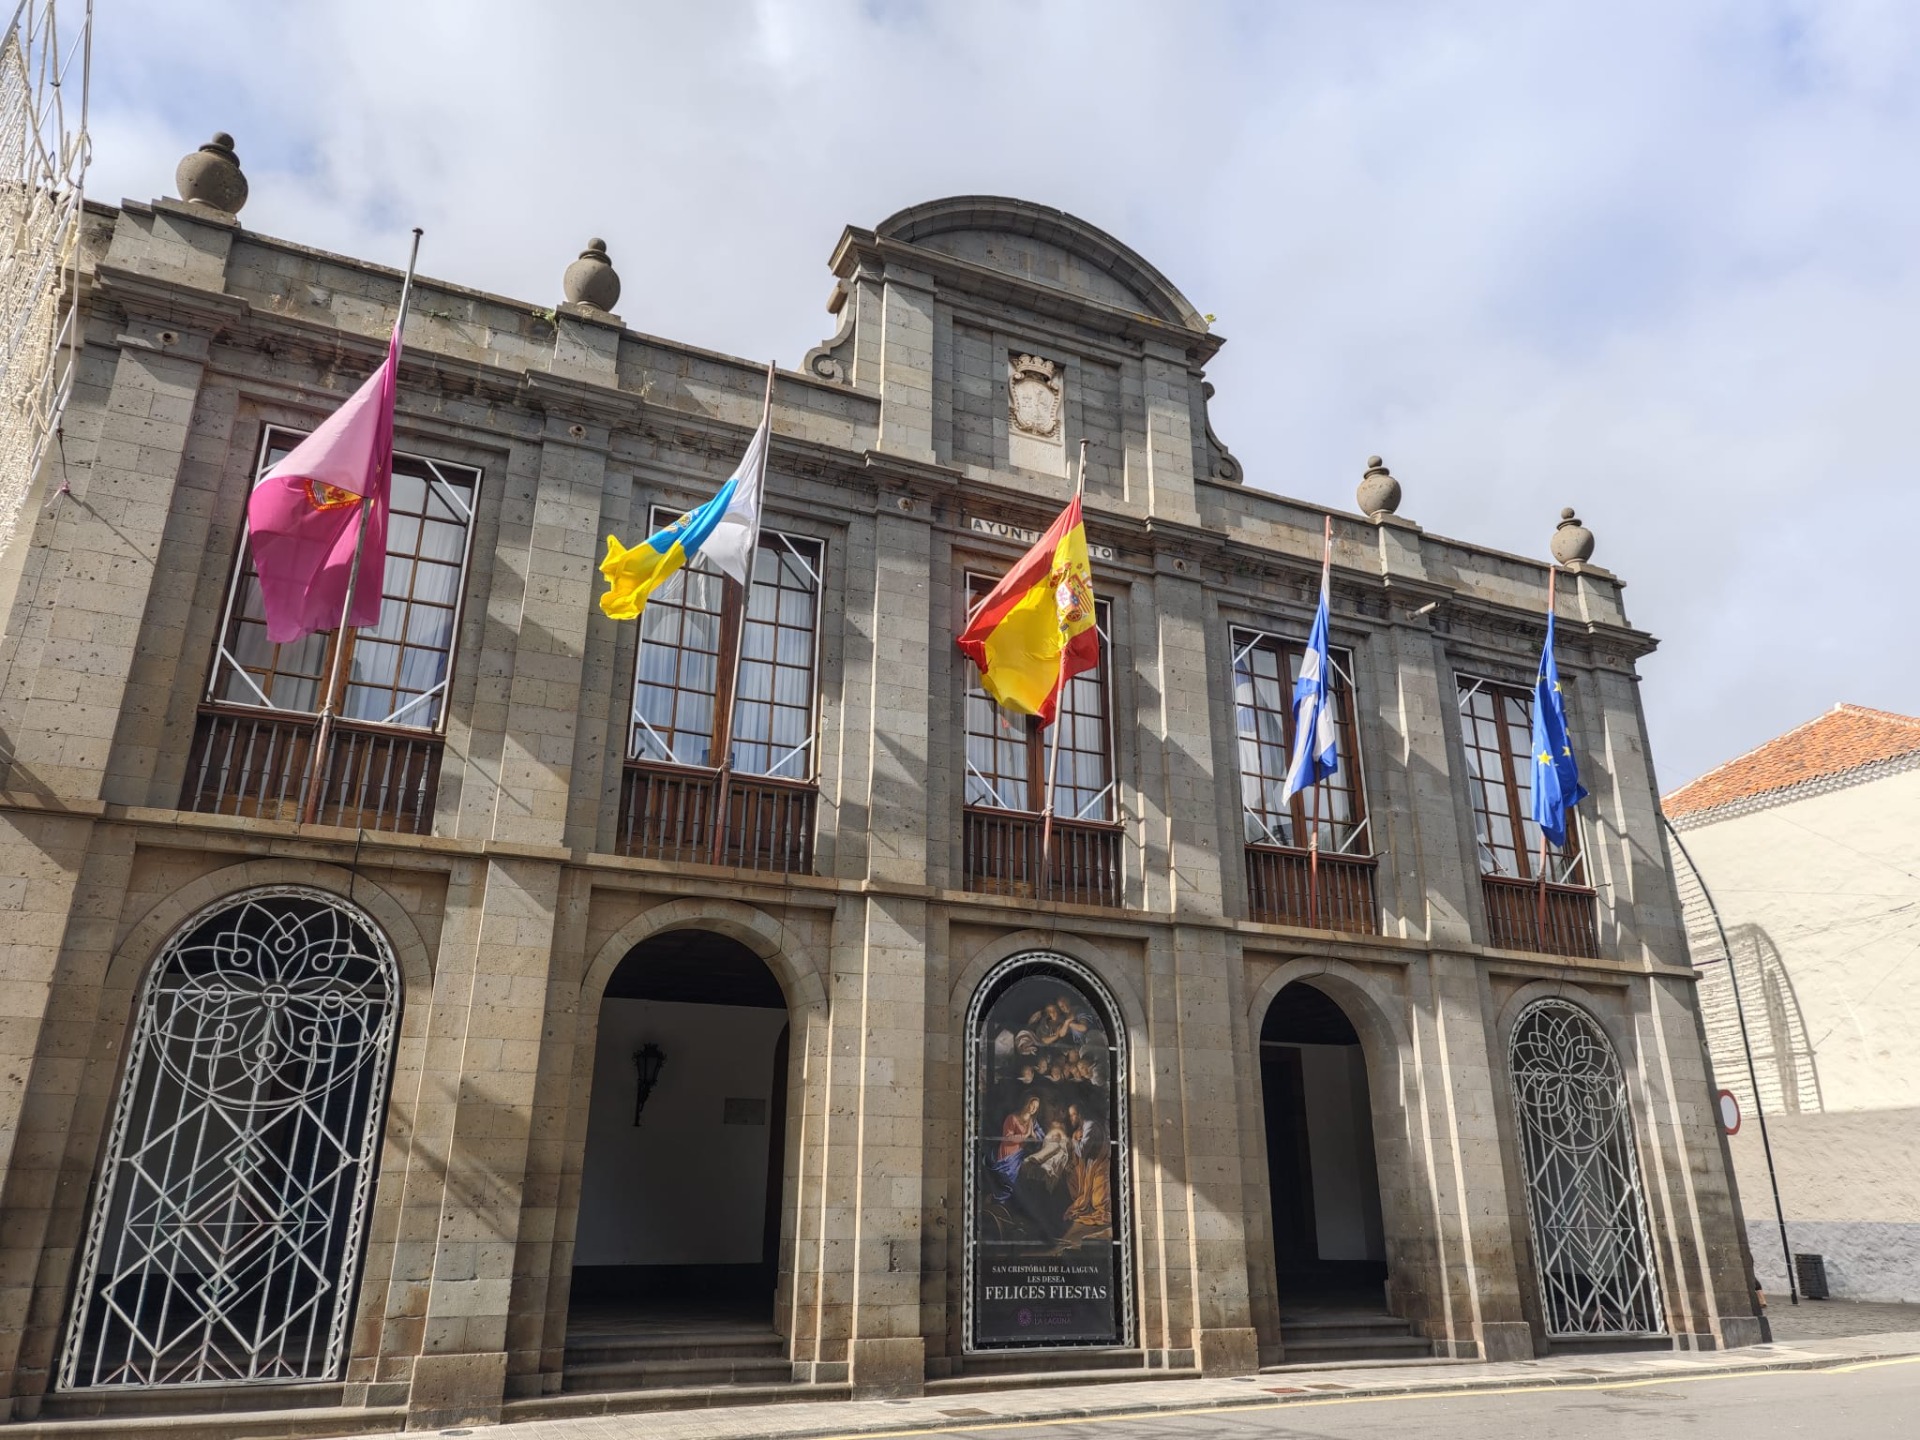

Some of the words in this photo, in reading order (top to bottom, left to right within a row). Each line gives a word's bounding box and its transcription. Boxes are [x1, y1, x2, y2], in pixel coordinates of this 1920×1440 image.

[992, 1265, 1006, 1273] SAN
[1008, 1264, 1047, 1273] CRISTÓBAL
[1049, 1265, 1059, 1273] DE
[1060, 1265, 1070, 1273] LA
[1072, 1266, 1098, 1274] LAGUNA
[1027, 1275, 1041, 1283] LES
[1042, 1275, 1065, 1283] DESEA
[985, 1285, 1046, 1300] FELICES
[1050, 1285, 1107, 1299] FIESTAS
